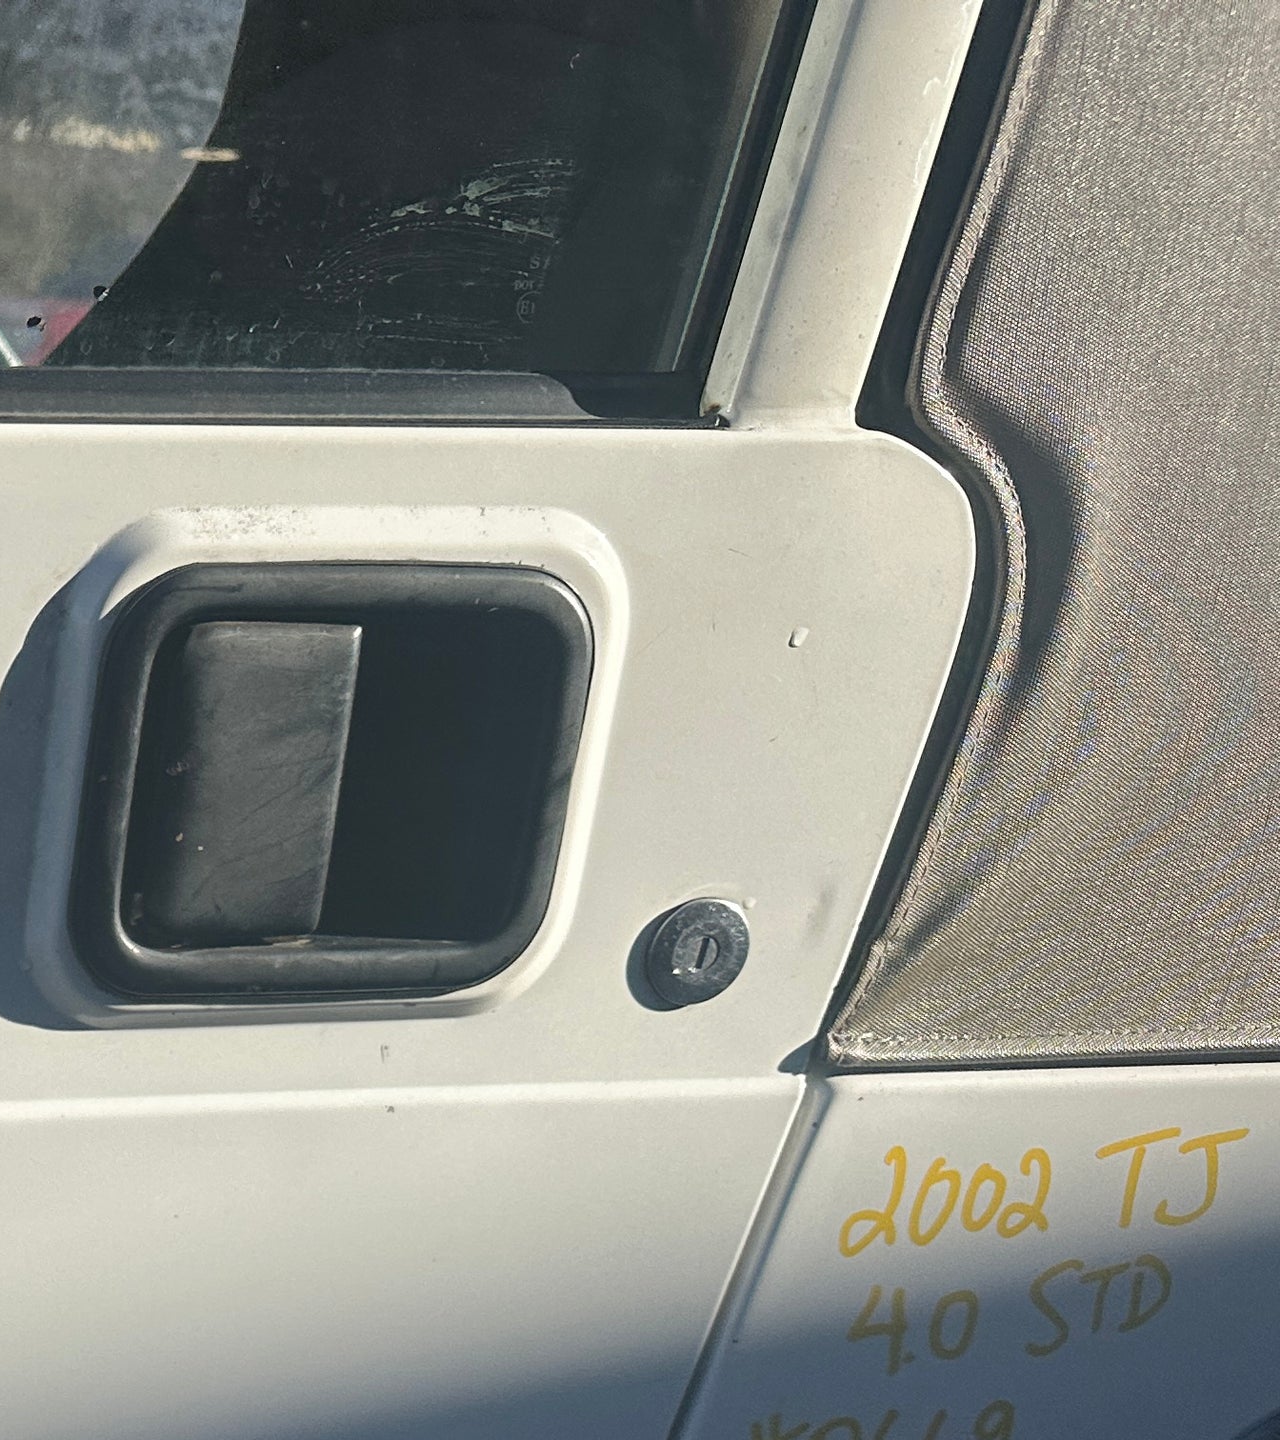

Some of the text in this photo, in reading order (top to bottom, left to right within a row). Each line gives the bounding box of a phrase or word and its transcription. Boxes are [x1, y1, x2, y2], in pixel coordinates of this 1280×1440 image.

[838, 1126, 1250, 1258] 2002 TJ
[1024, 1253, 1173, 1359] STD
